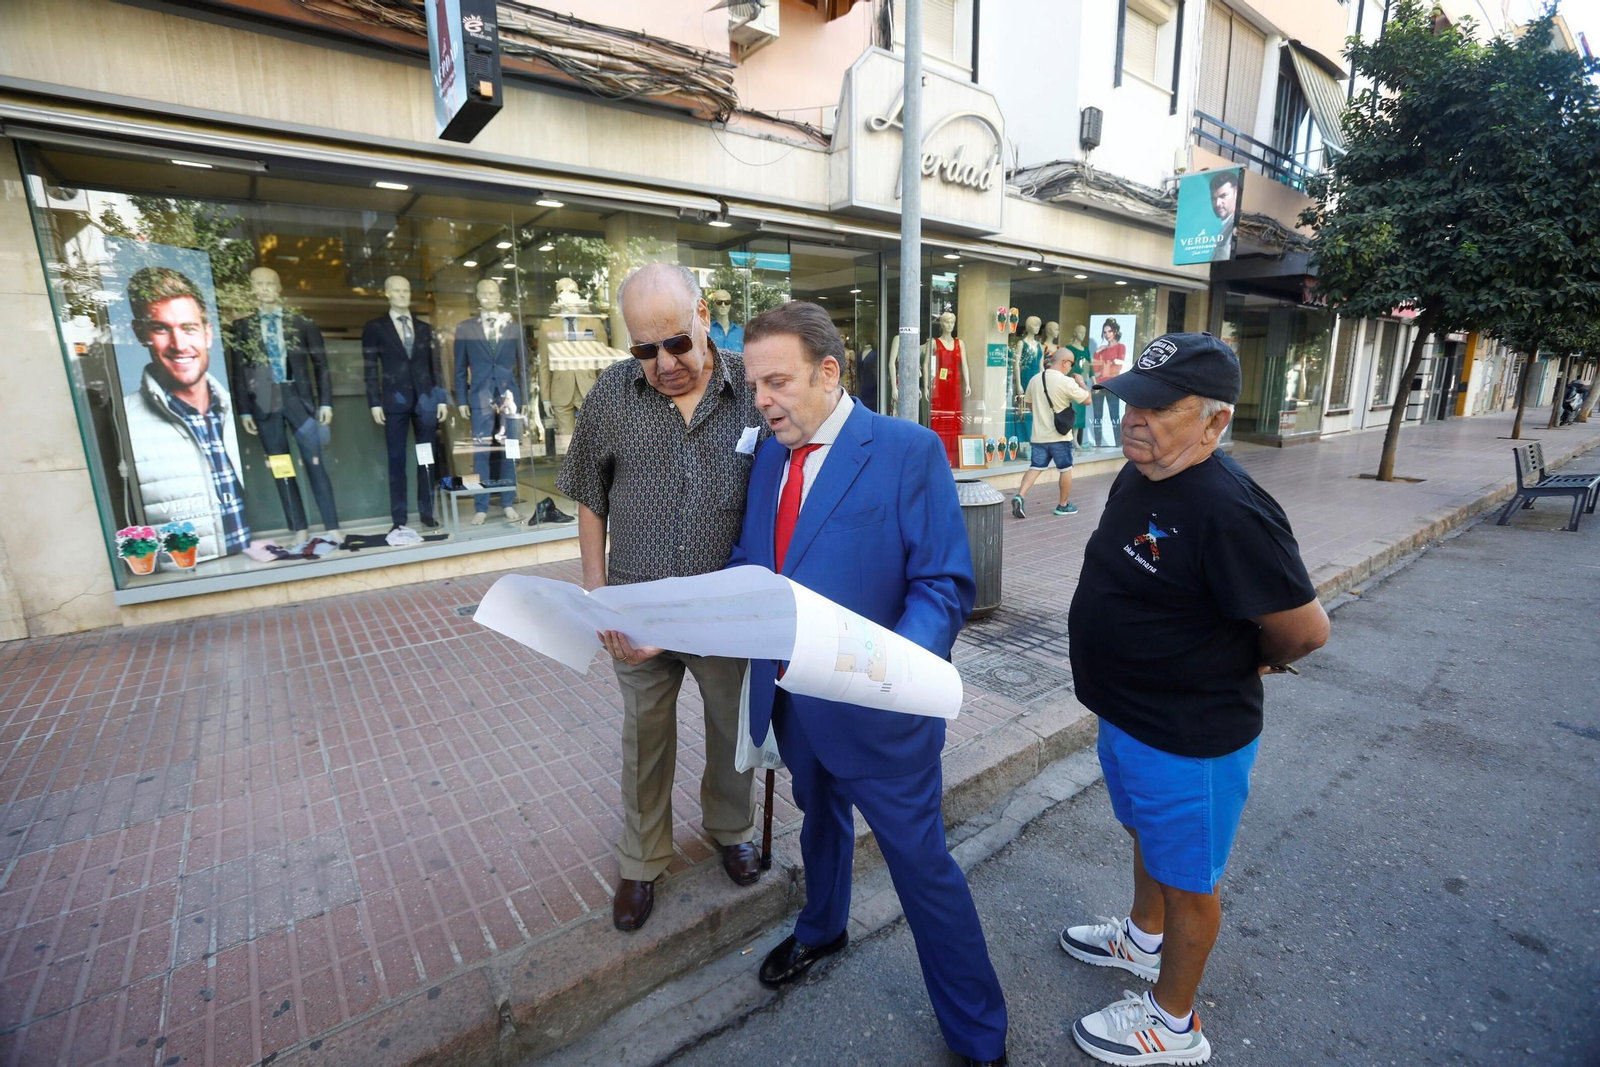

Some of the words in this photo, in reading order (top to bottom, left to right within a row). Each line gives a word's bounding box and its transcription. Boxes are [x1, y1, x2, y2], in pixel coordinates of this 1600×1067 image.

[1181, 234, 1224, 246] VERDAD
[1123, 544, 1136, 557] blue
[1135, 553, 1157, 573] banana
